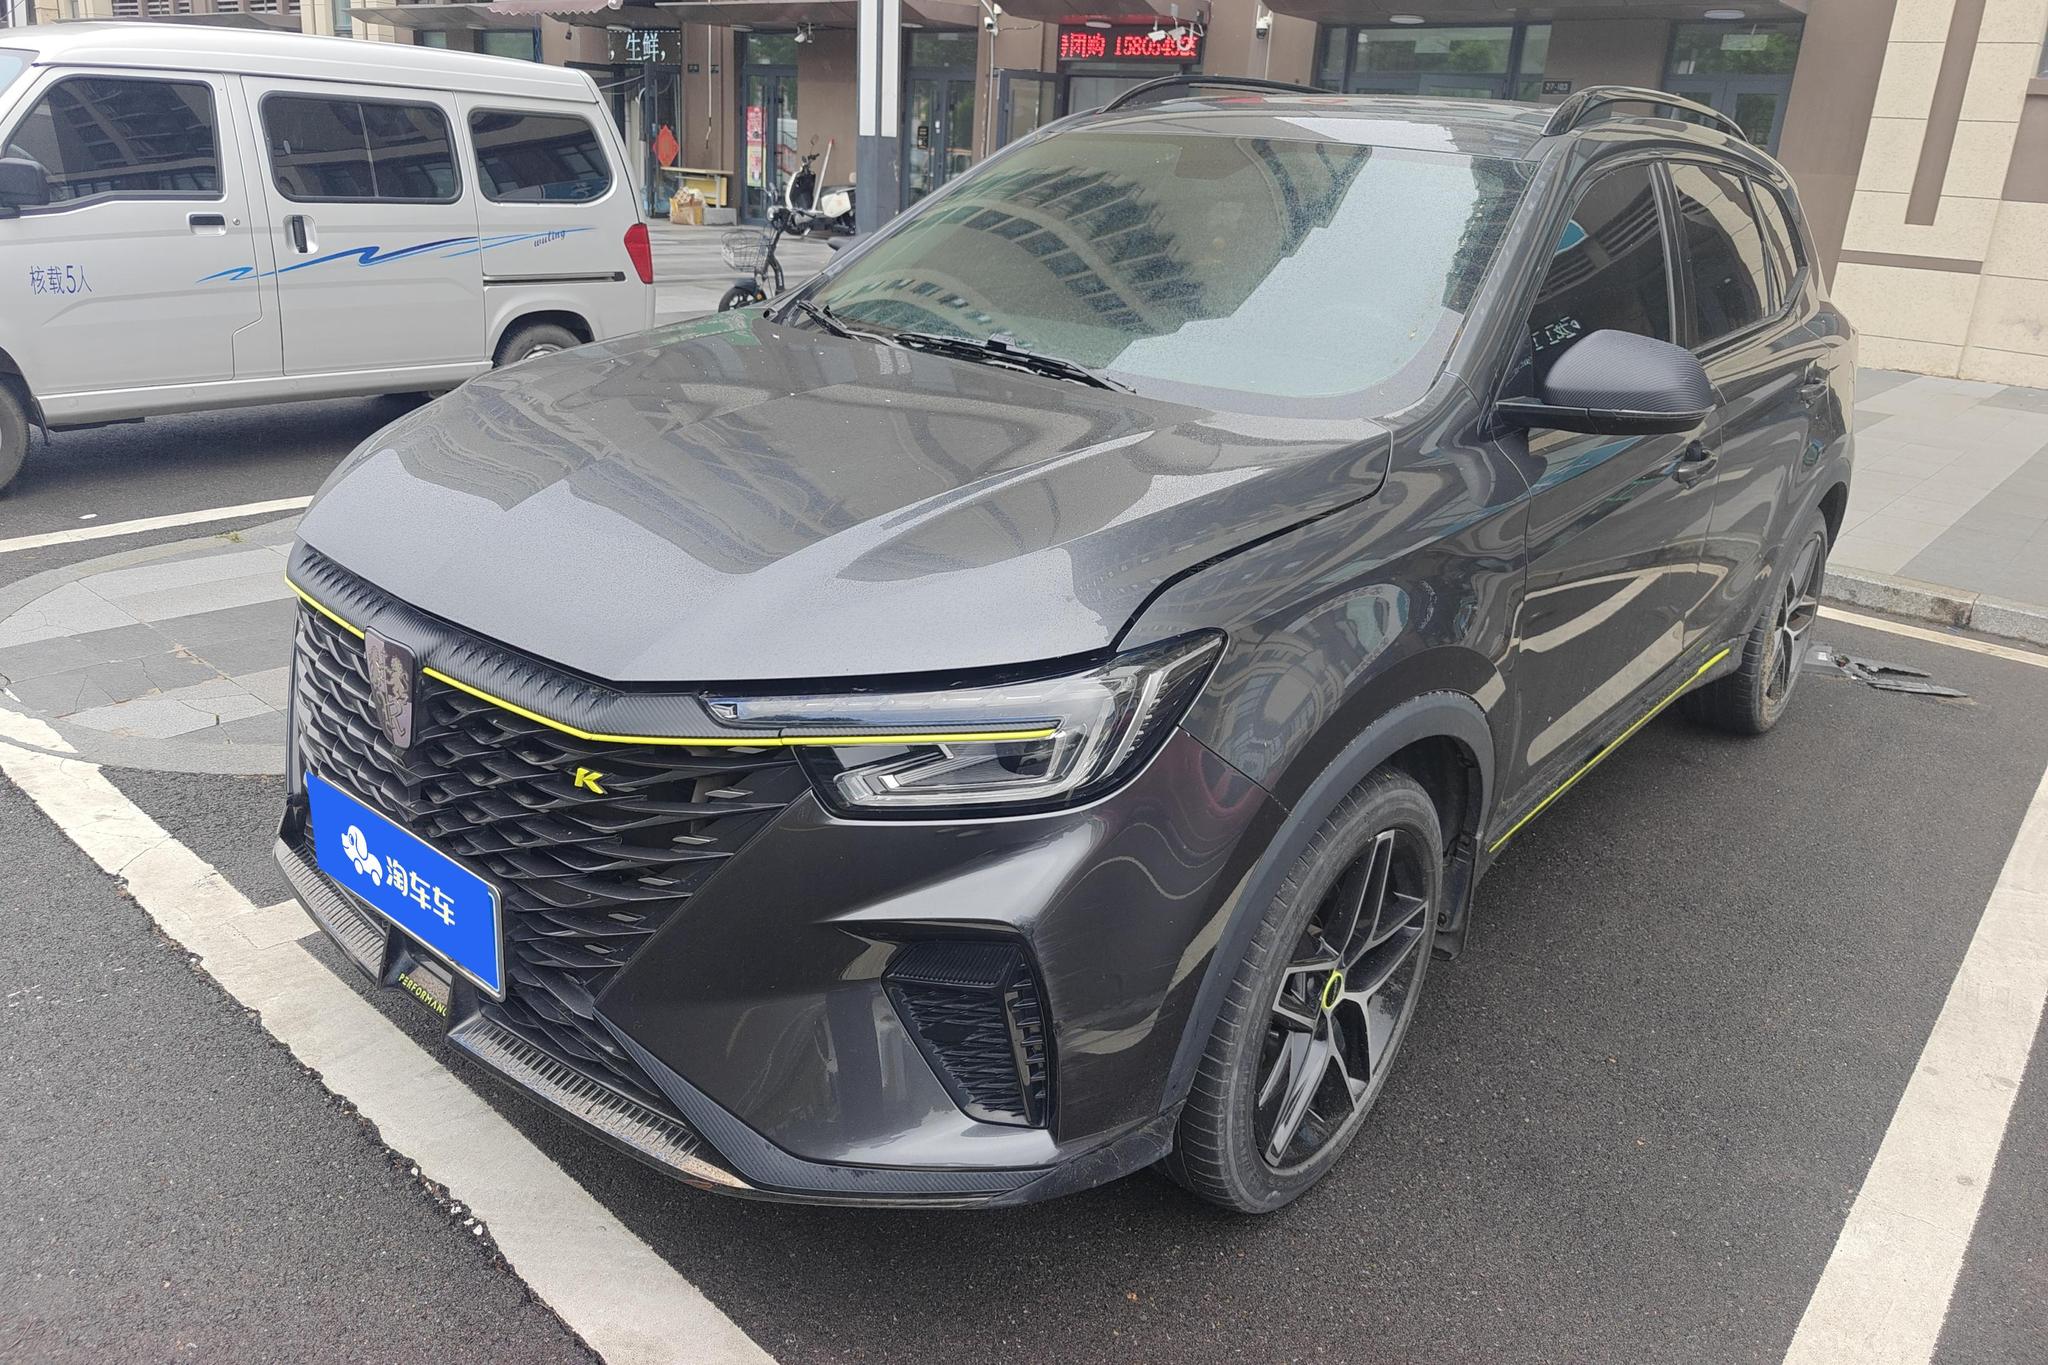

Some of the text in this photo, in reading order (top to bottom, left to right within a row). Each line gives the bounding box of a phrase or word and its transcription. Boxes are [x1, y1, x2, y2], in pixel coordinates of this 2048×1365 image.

[29, 265, 93, 295] 核载5人
[574, 767, 605, 794] K
